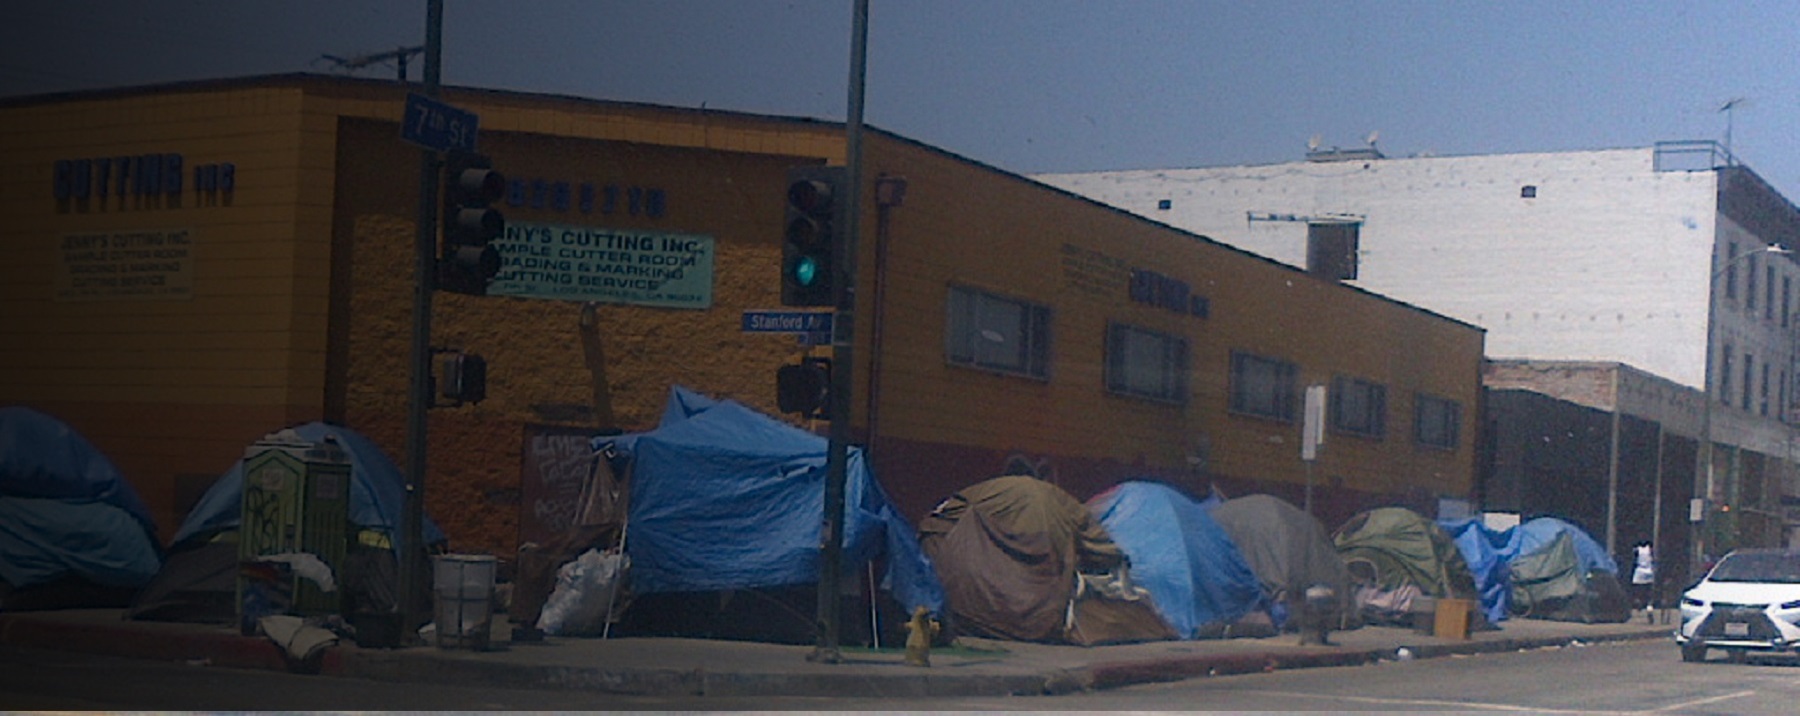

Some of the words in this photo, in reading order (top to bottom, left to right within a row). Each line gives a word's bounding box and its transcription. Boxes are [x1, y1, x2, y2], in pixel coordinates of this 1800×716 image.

[112, 232, 164, 248] CUTTING
[501, 227, 552, 244] NY'S
[561, 230, 654, 251] CUTTING
[559, 248, 631, 263] CUTTER
[638, 254, 695, 266] ROOM
[596, 263, 683, 281] MARKING
[578, 275, 660, 291] SERVICE
[751, 315, 803, 329] Stanford
